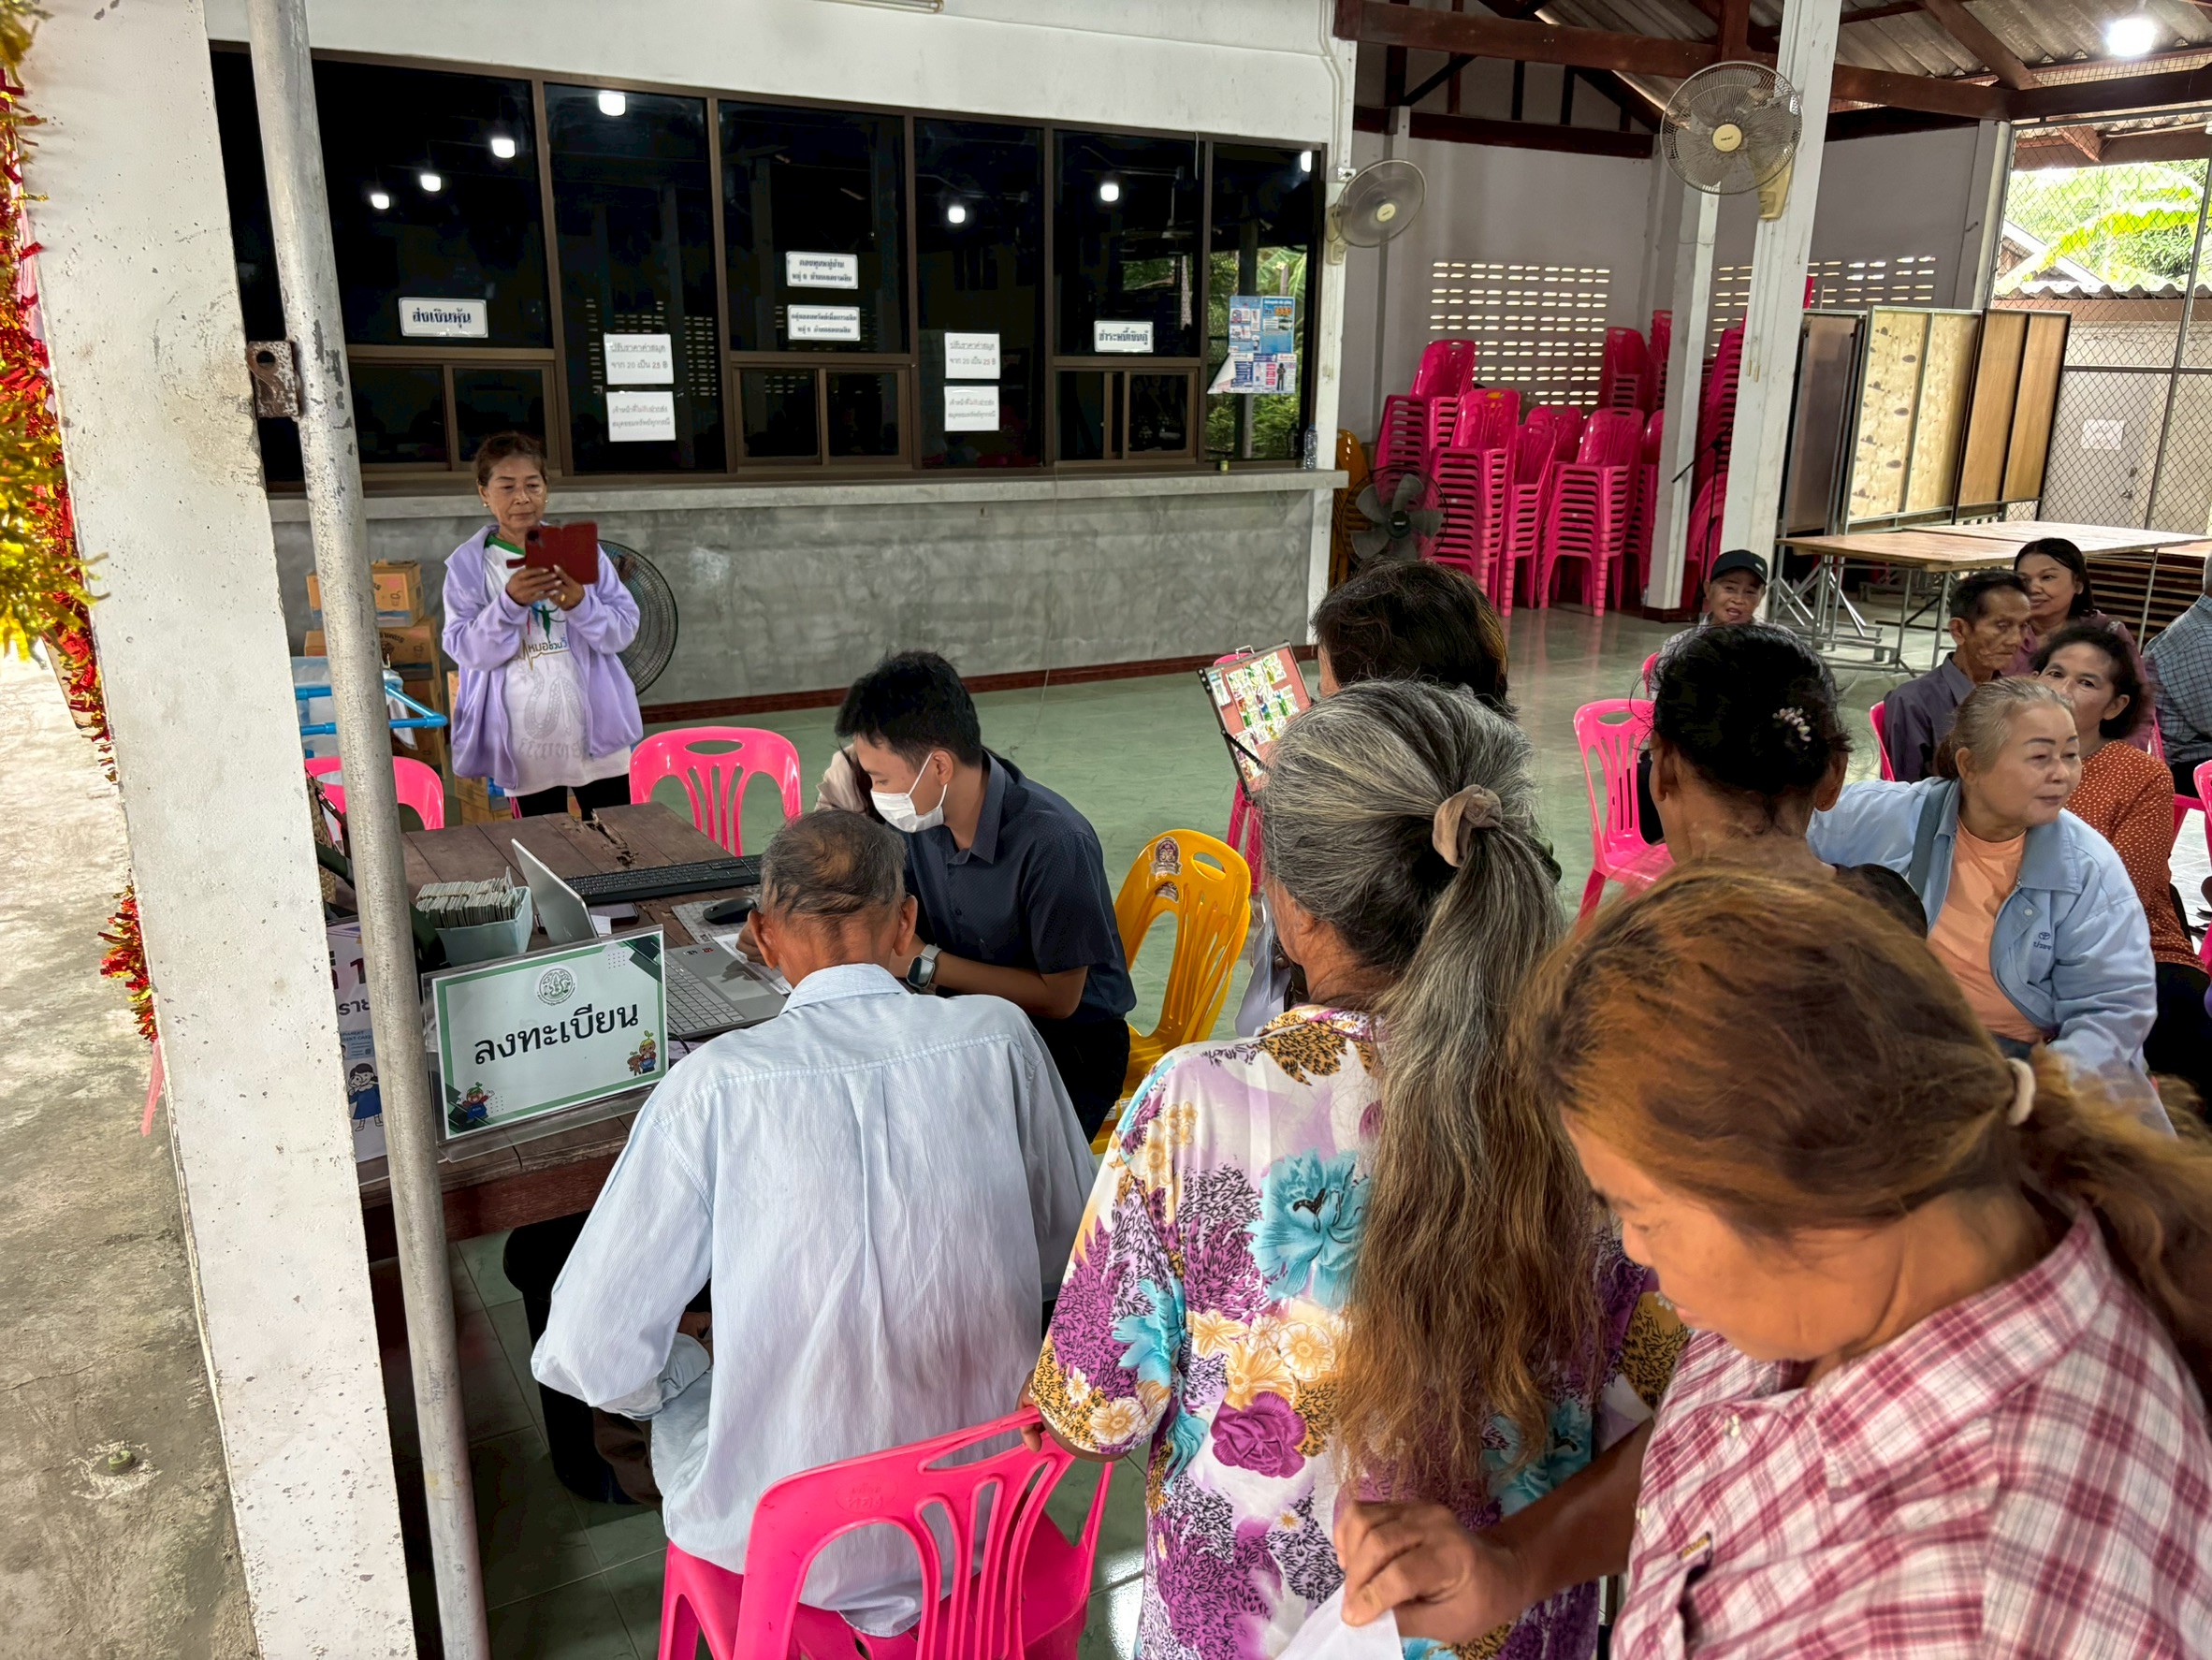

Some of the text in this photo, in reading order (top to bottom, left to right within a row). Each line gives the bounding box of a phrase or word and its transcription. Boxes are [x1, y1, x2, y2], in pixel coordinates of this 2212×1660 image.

[413, 307, 472, 328] ส่งเงินหุ้น
[474, 1003, 639, 1065] ลงทะเบียน
